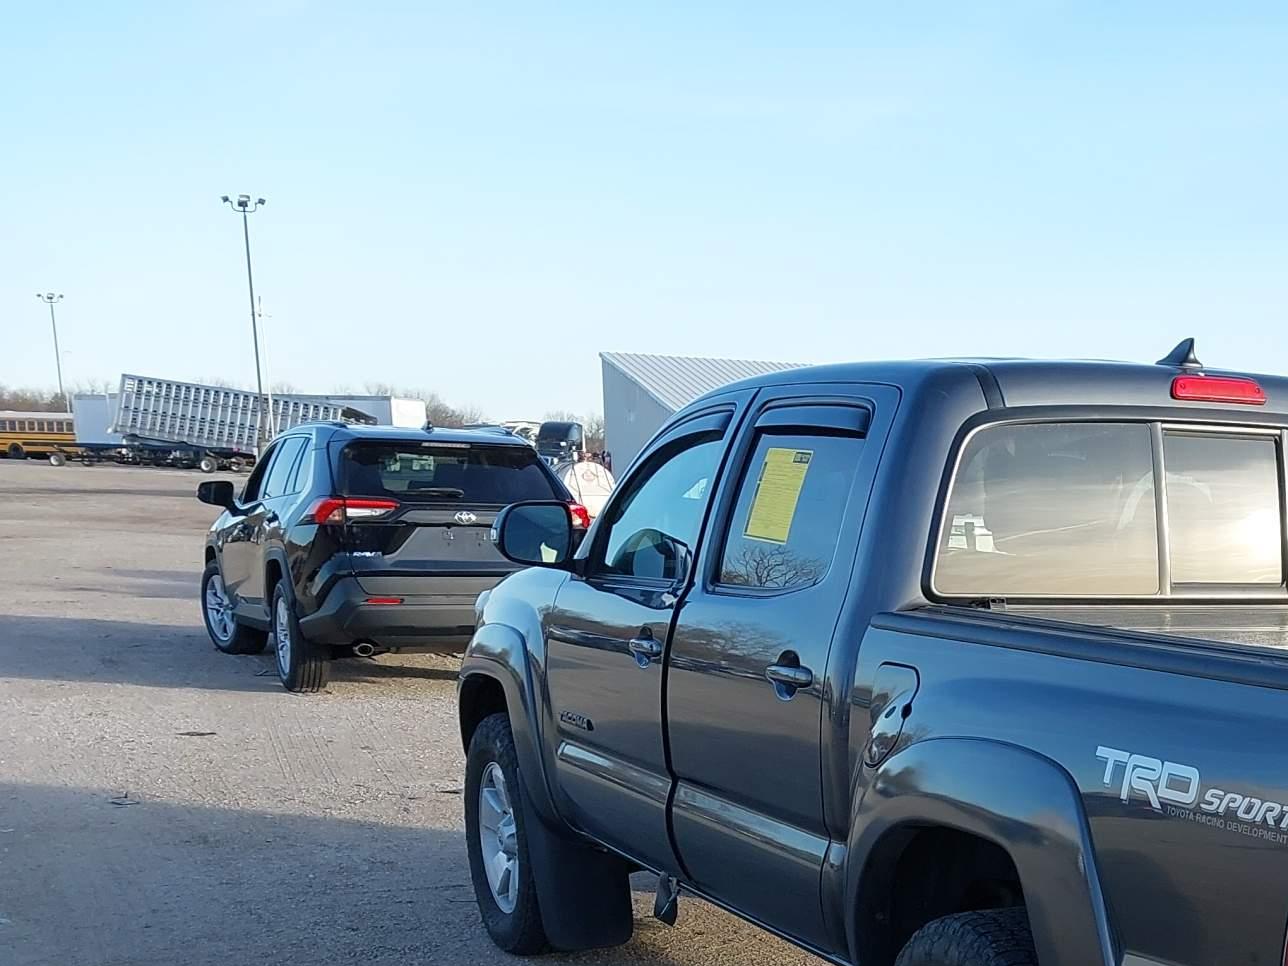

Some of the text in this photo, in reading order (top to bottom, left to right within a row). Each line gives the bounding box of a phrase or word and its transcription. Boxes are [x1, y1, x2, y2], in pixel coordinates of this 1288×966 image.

[1095, 745, 1200, 812] TRD
[1166, 805, 1288, 845] TOYOTA RACING DEVELOPMENT
